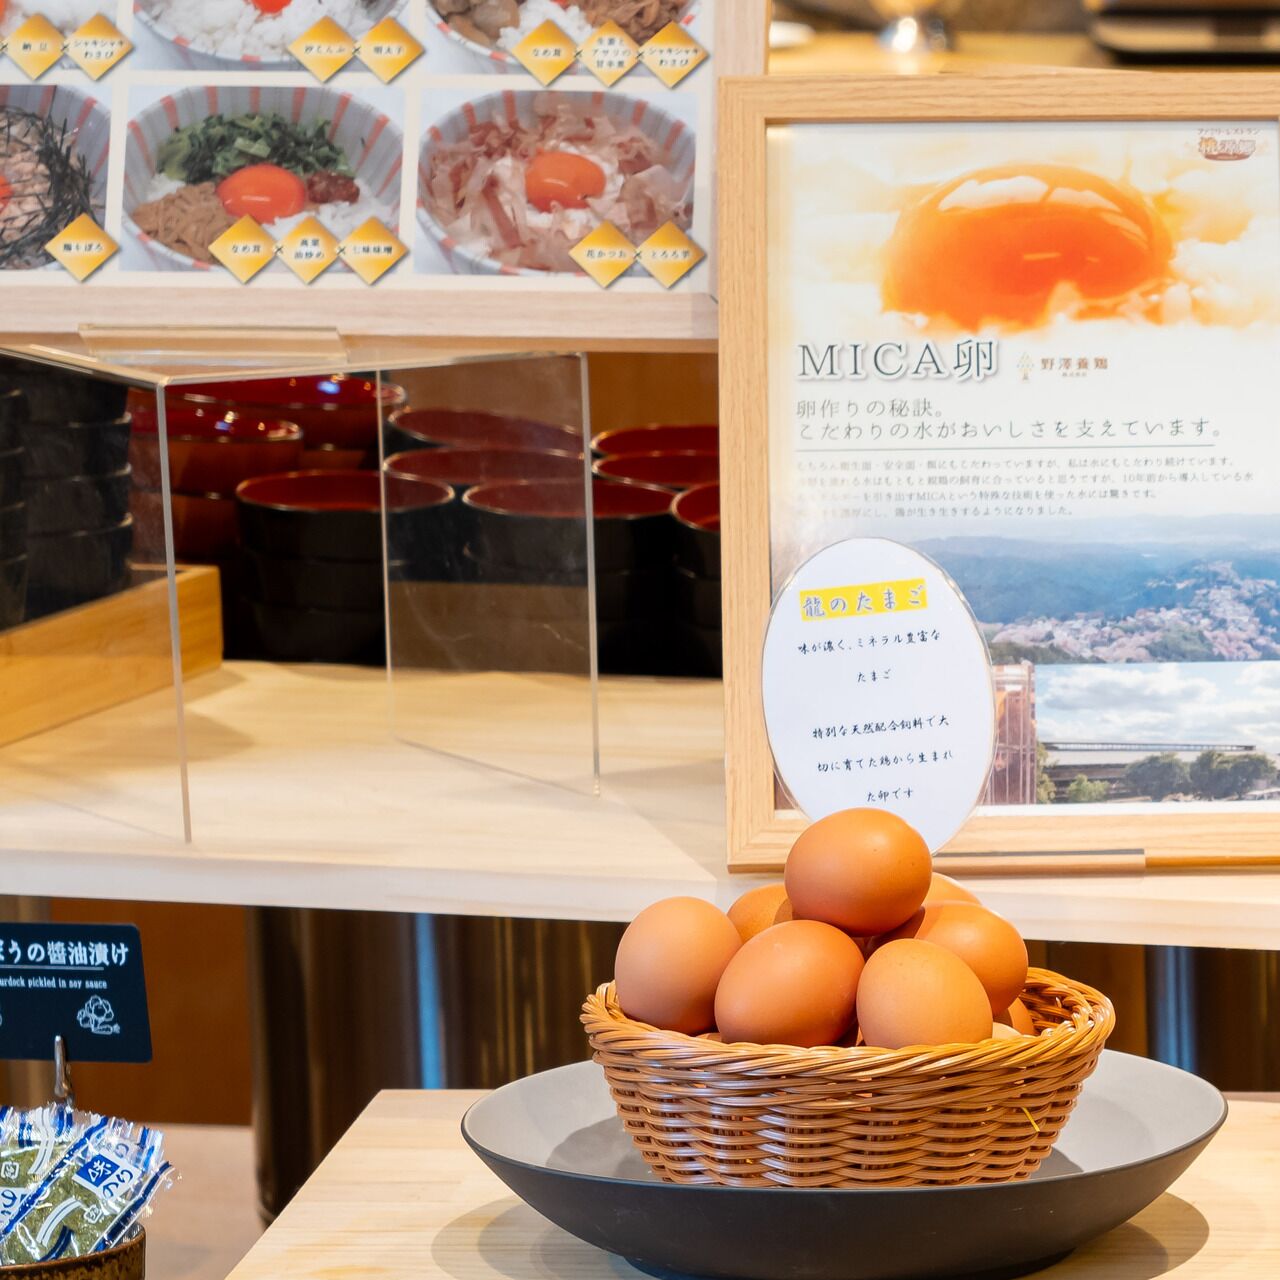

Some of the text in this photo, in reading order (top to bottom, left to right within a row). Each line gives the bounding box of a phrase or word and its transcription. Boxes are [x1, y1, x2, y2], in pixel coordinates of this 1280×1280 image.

[799, 339, 996, 377] MICA卵
[796, 398, 944, 420] 卵作りの秘訣。
[799, 418, 1222, 442] こだわりの水がおいしさを支えています。
[801, 584, 926, 619] 龍のたまご
[797, 629, 941, 656] 味が濃く、ミネラル豊富な
[856, 668, 893, 683] たまご
[811, 714, 950, 740] 特別な天然配合飼料で大
[816, 749, 954, 773] 切に育てた鶏から生まれ
[866, 786, 915, 804] た卵です
[0, 975, 25, 988] urdock
